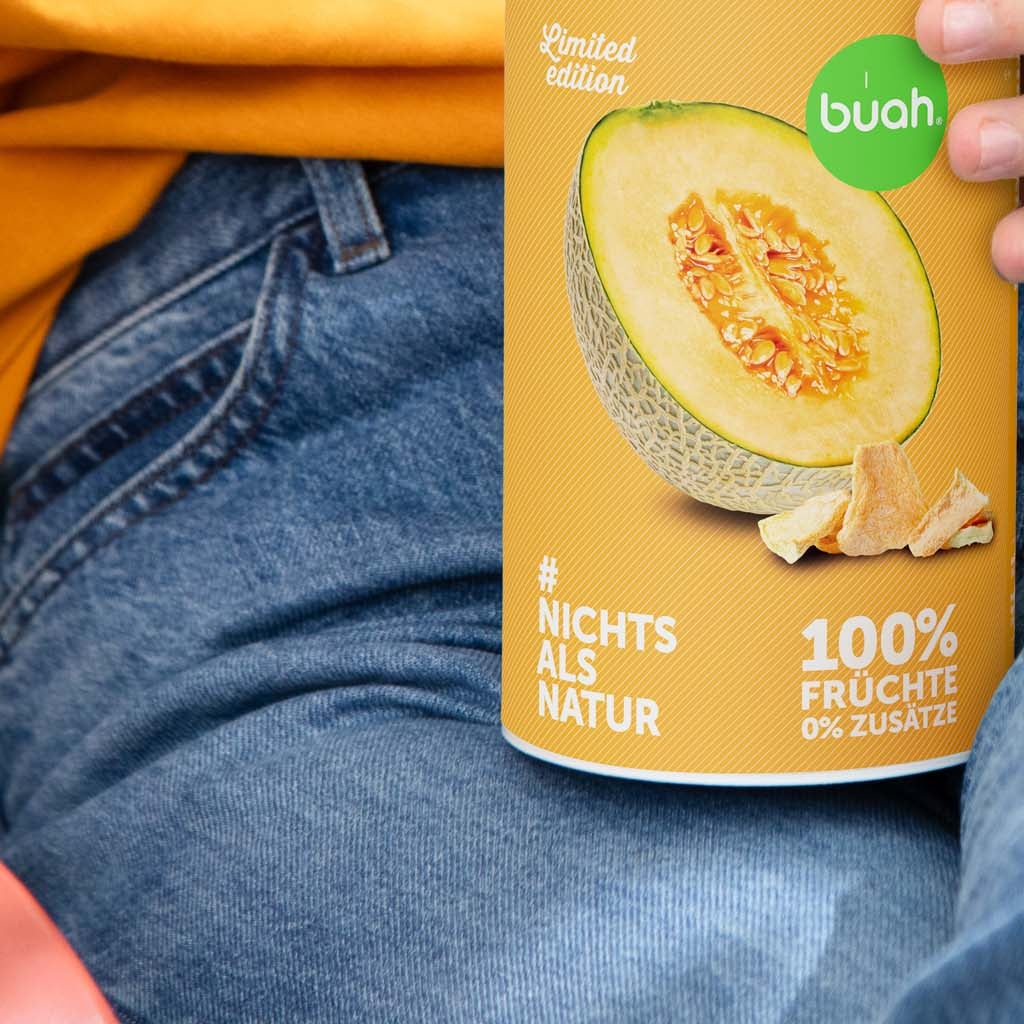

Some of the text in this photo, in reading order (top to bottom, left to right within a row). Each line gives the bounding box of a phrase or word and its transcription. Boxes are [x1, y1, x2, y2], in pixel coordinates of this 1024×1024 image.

[539, 21, 638, 64] Limited
[545, 62, 629, 96] edition
[538, 556, 558, 593] #
[538, 597, 678, 654] NICHTS
[801, 604, 958, 672] 100%
[536, 639, 597, 686] ALS
[537, 679, 661, 737] NATUR
[801, 665, 958, 711] FRÜCHTE
[801, 701, 957, 740] 0% ZUSÄTZE
